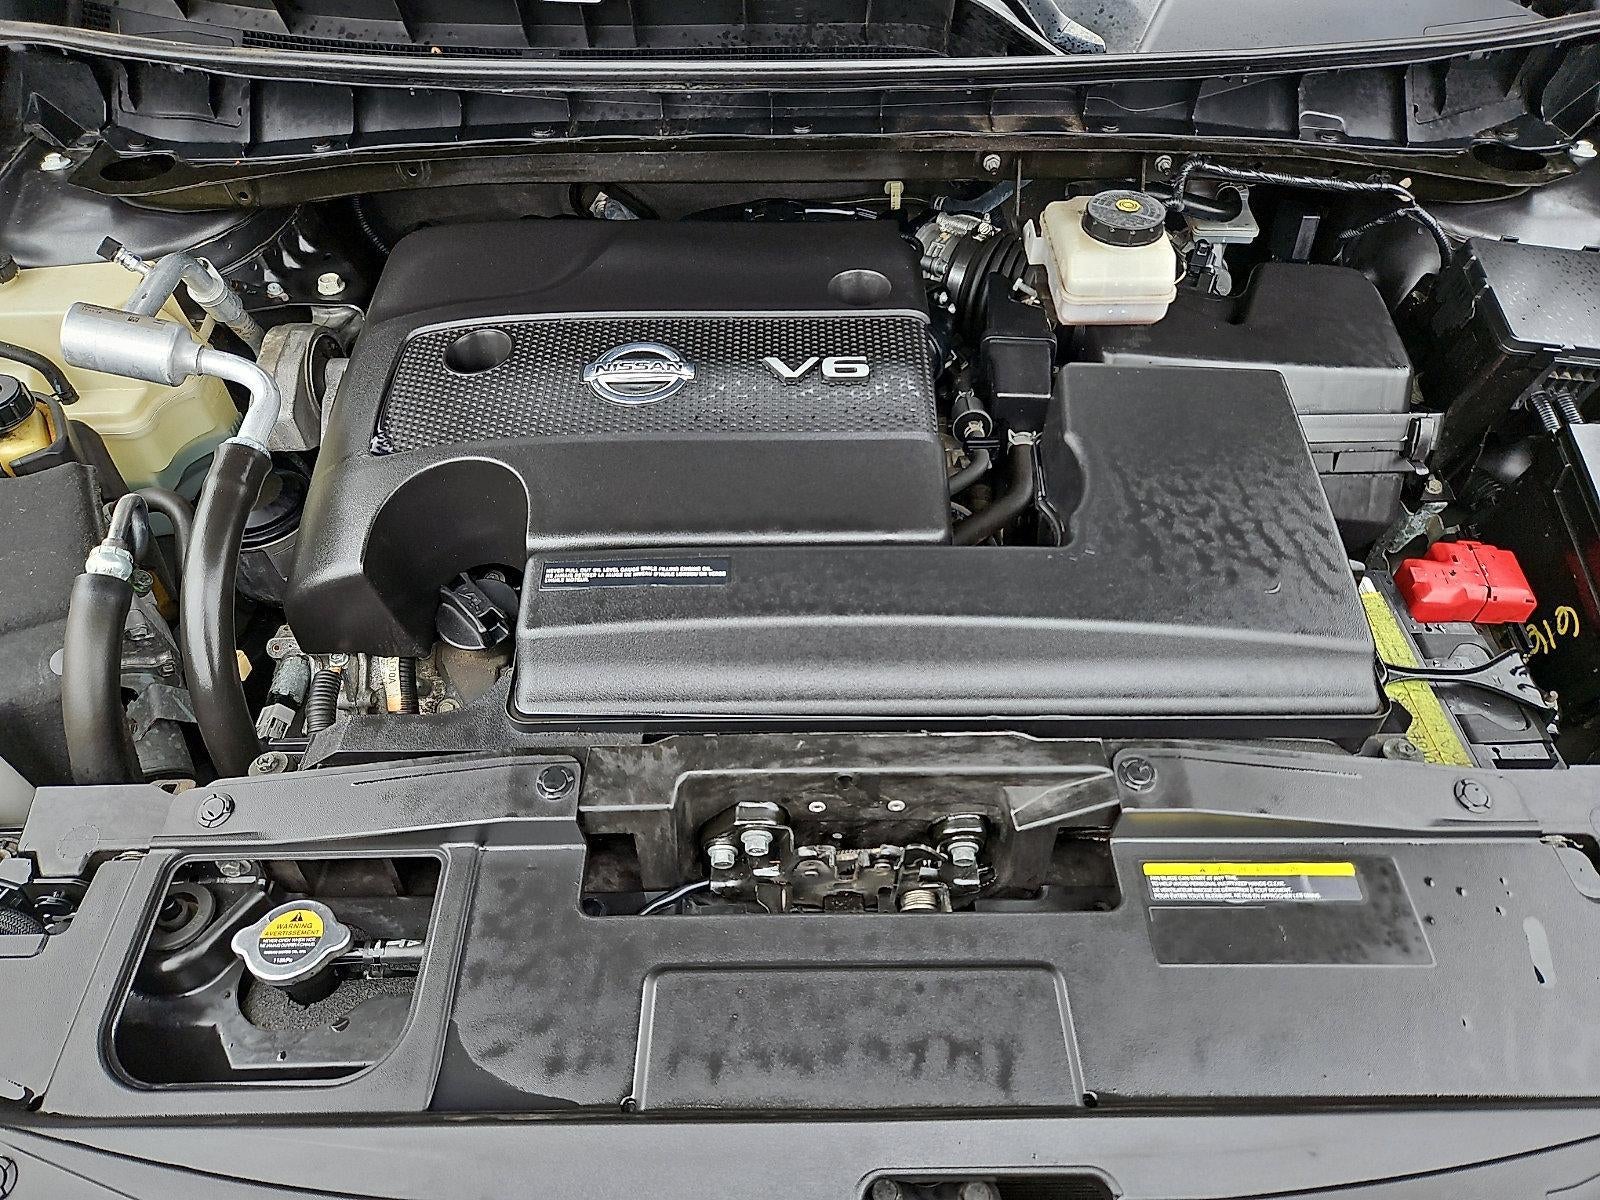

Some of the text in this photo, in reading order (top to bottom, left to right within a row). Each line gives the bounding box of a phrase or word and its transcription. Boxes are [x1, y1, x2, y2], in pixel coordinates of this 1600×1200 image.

[595, 360, 683, 373] NISSAN
[762, 356, 870, 382] V6
[276, 922, 313, 930] WARNING
